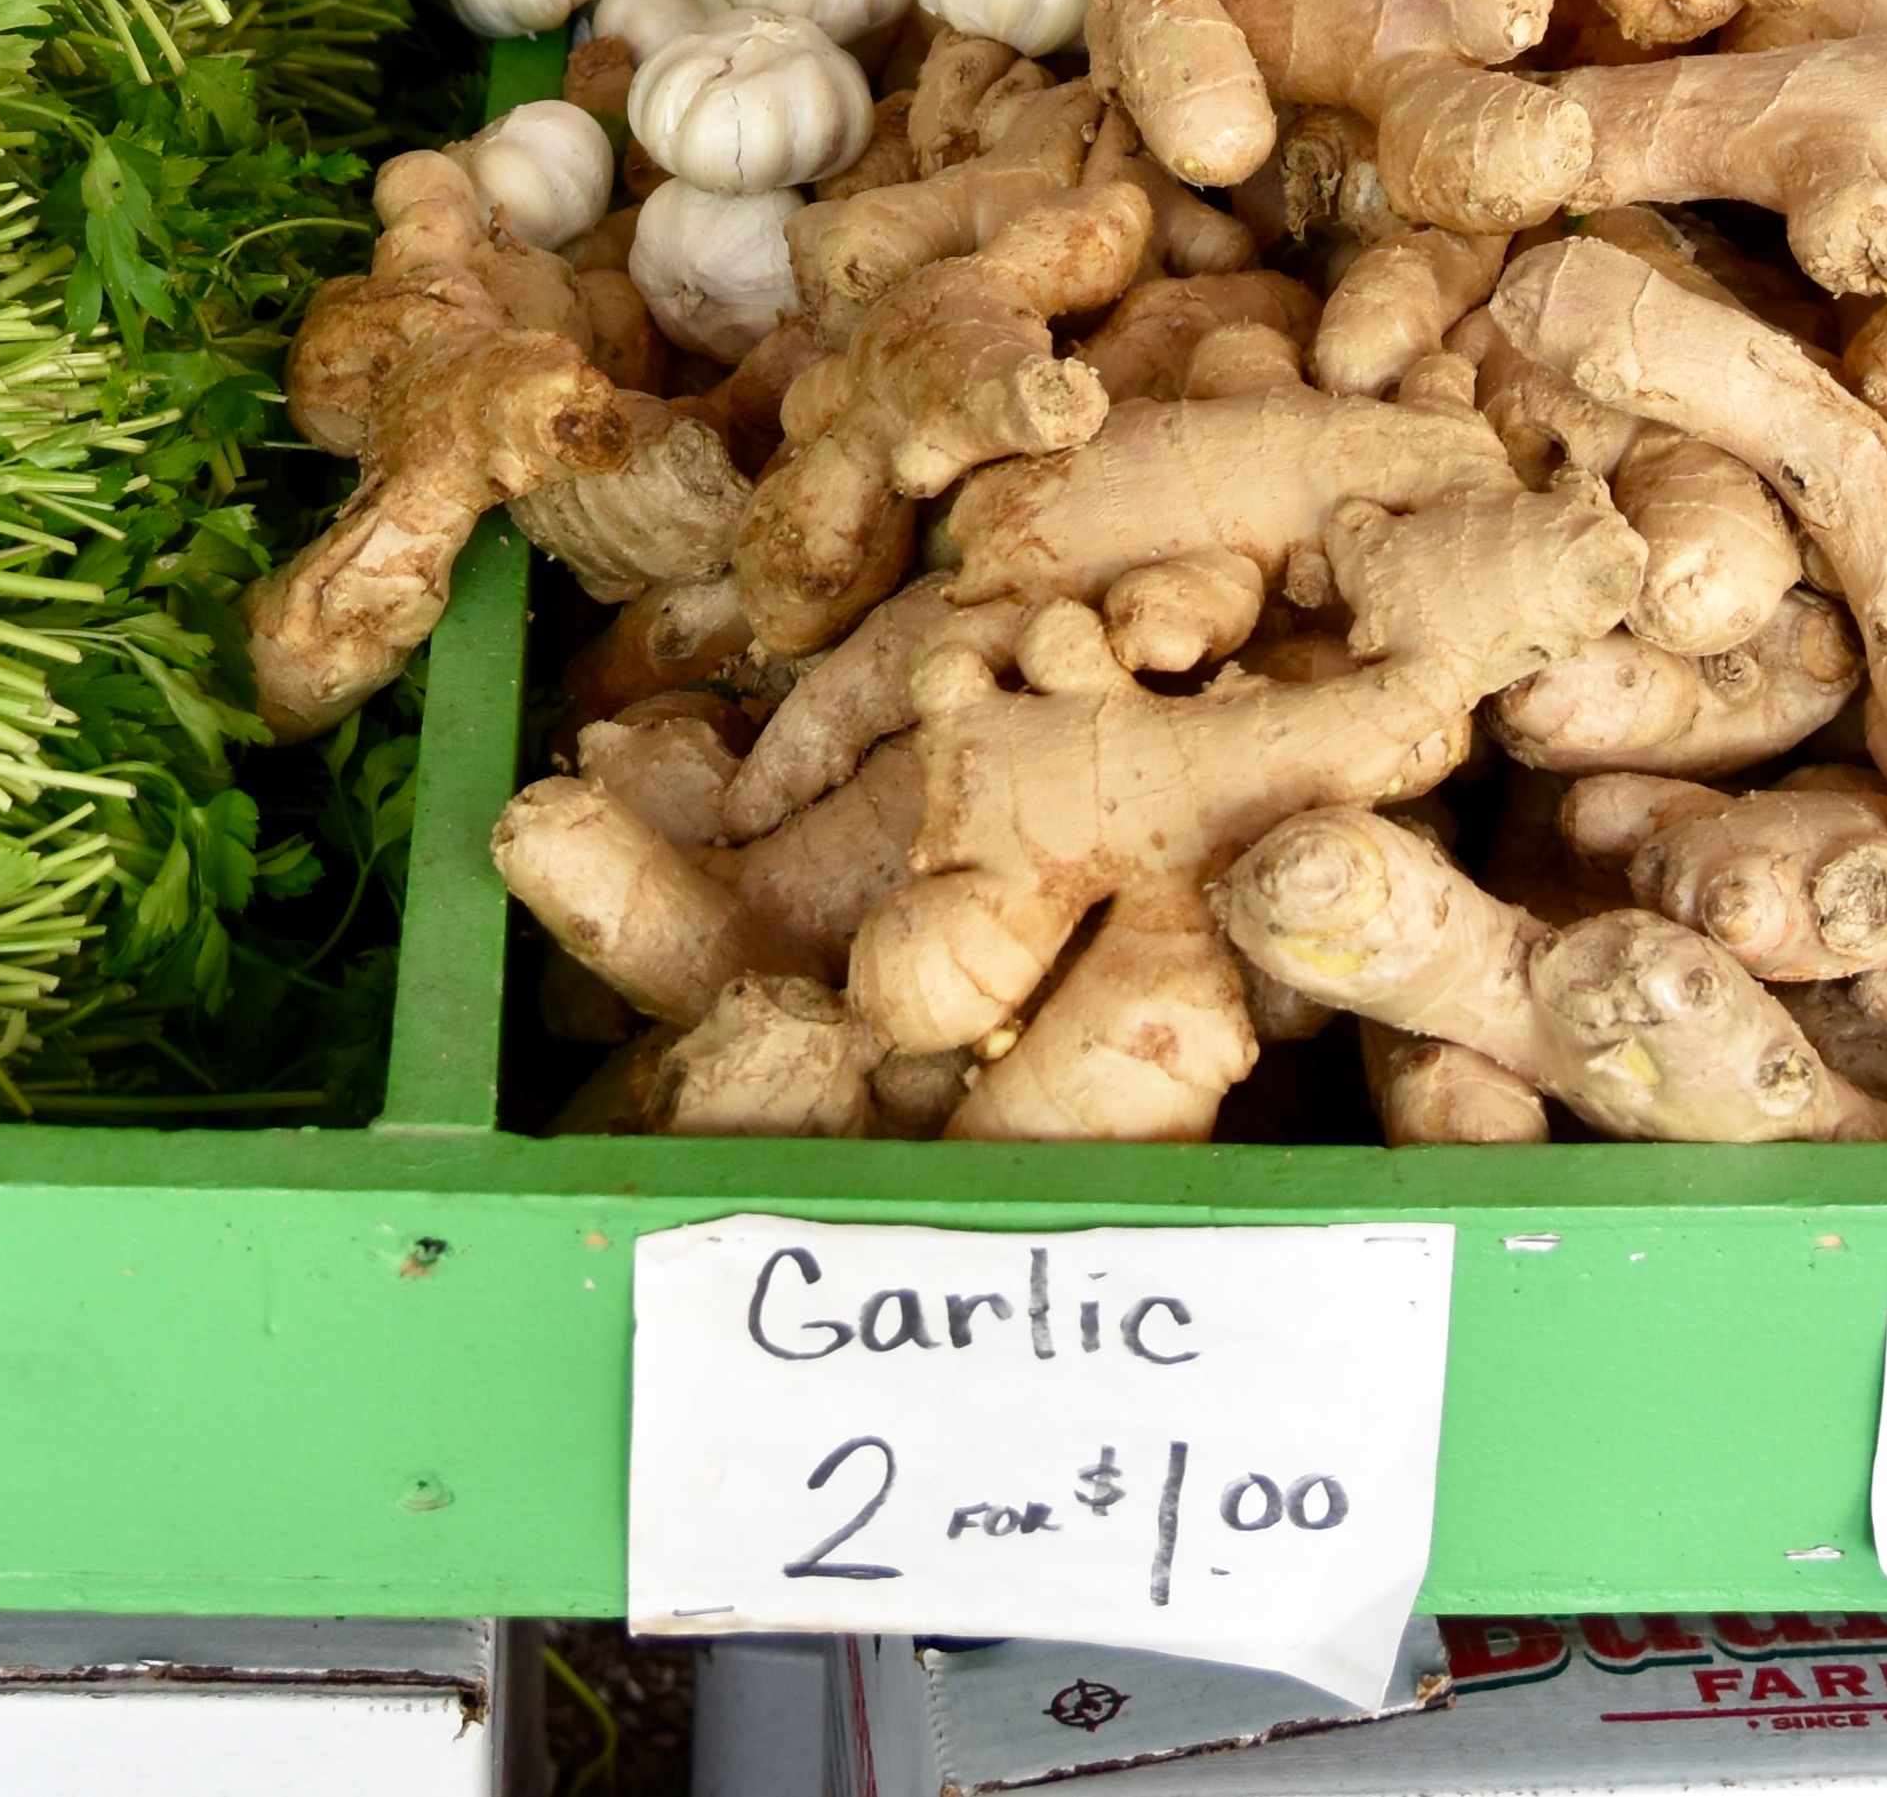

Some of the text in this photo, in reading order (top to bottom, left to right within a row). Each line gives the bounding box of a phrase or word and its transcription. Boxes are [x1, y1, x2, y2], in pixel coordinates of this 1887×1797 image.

[748, 1245, 1200, 1366] Garlic
[782, 1434, 1351, 1607] 2 FOR $1.00
[1771, 1713, 1870, 1730] SINCE
